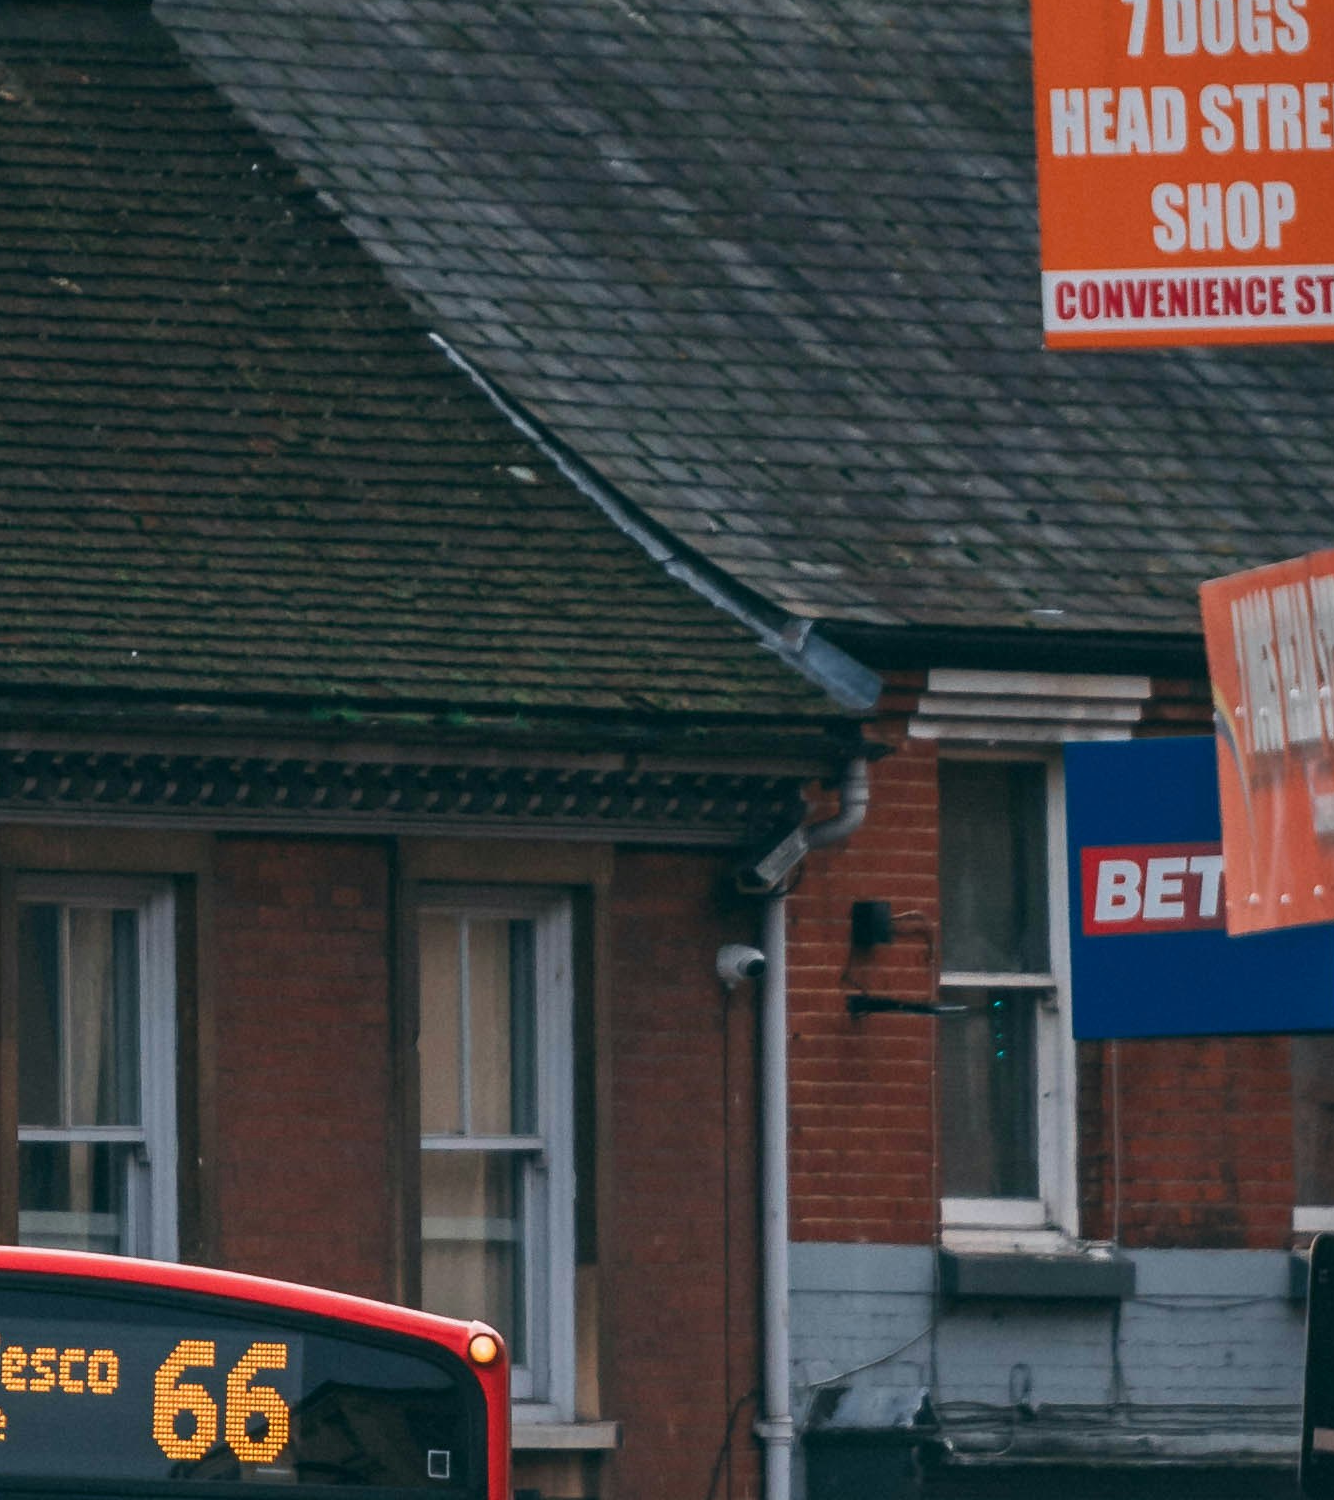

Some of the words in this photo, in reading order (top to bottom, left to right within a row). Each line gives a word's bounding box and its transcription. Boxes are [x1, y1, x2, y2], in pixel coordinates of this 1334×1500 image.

[1049, 86, 1187, 156] HEAD
[1151, 181, 1296, 253] SHOP
[1054, 275, 1286, 321] CONVENIENCE
[1093, 855, 1226, 923] BET
[152, 1339, 290, 1464] 66
